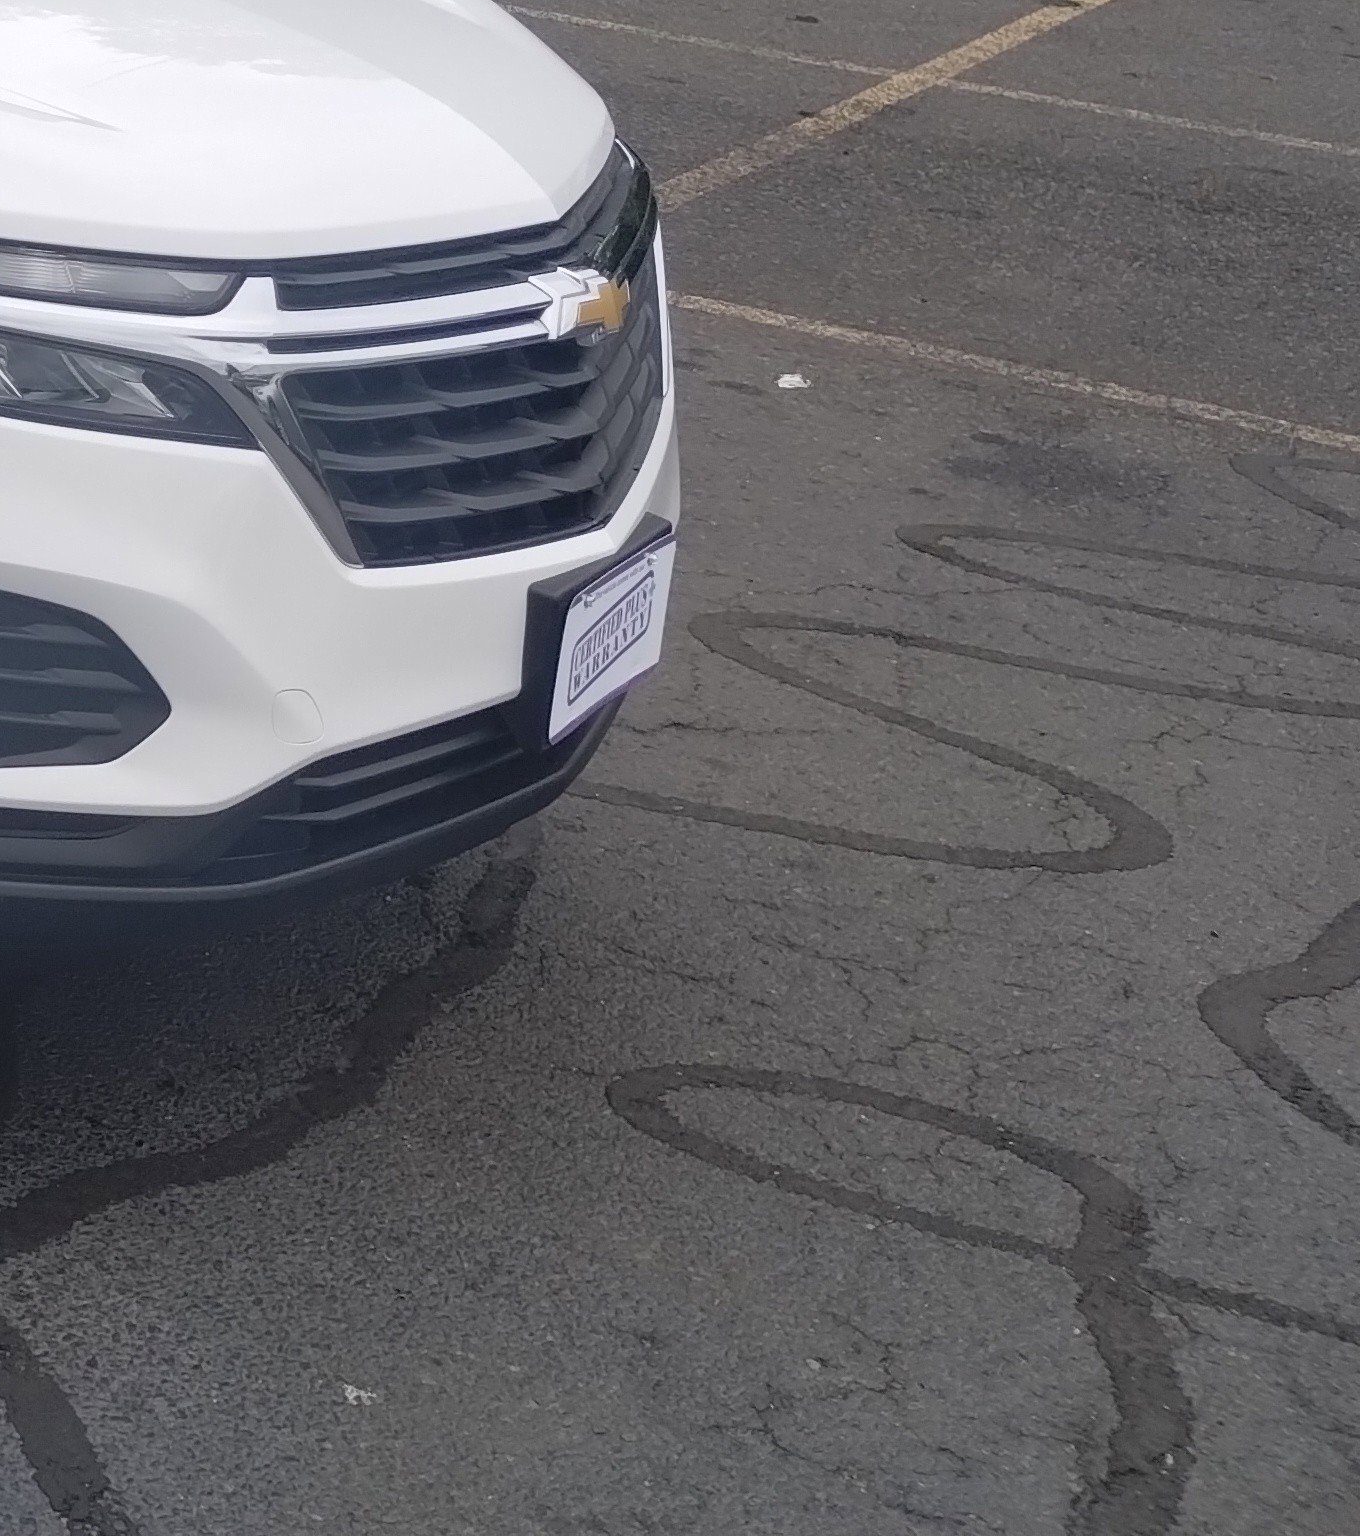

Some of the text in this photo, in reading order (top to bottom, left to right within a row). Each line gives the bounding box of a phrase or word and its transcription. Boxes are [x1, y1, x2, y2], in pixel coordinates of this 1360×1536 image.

[573, 607, 647, 693] WARRANTY
[574, 607, 623, 672] CERTIFIED
[624, 583, 649, 624] PLUS
